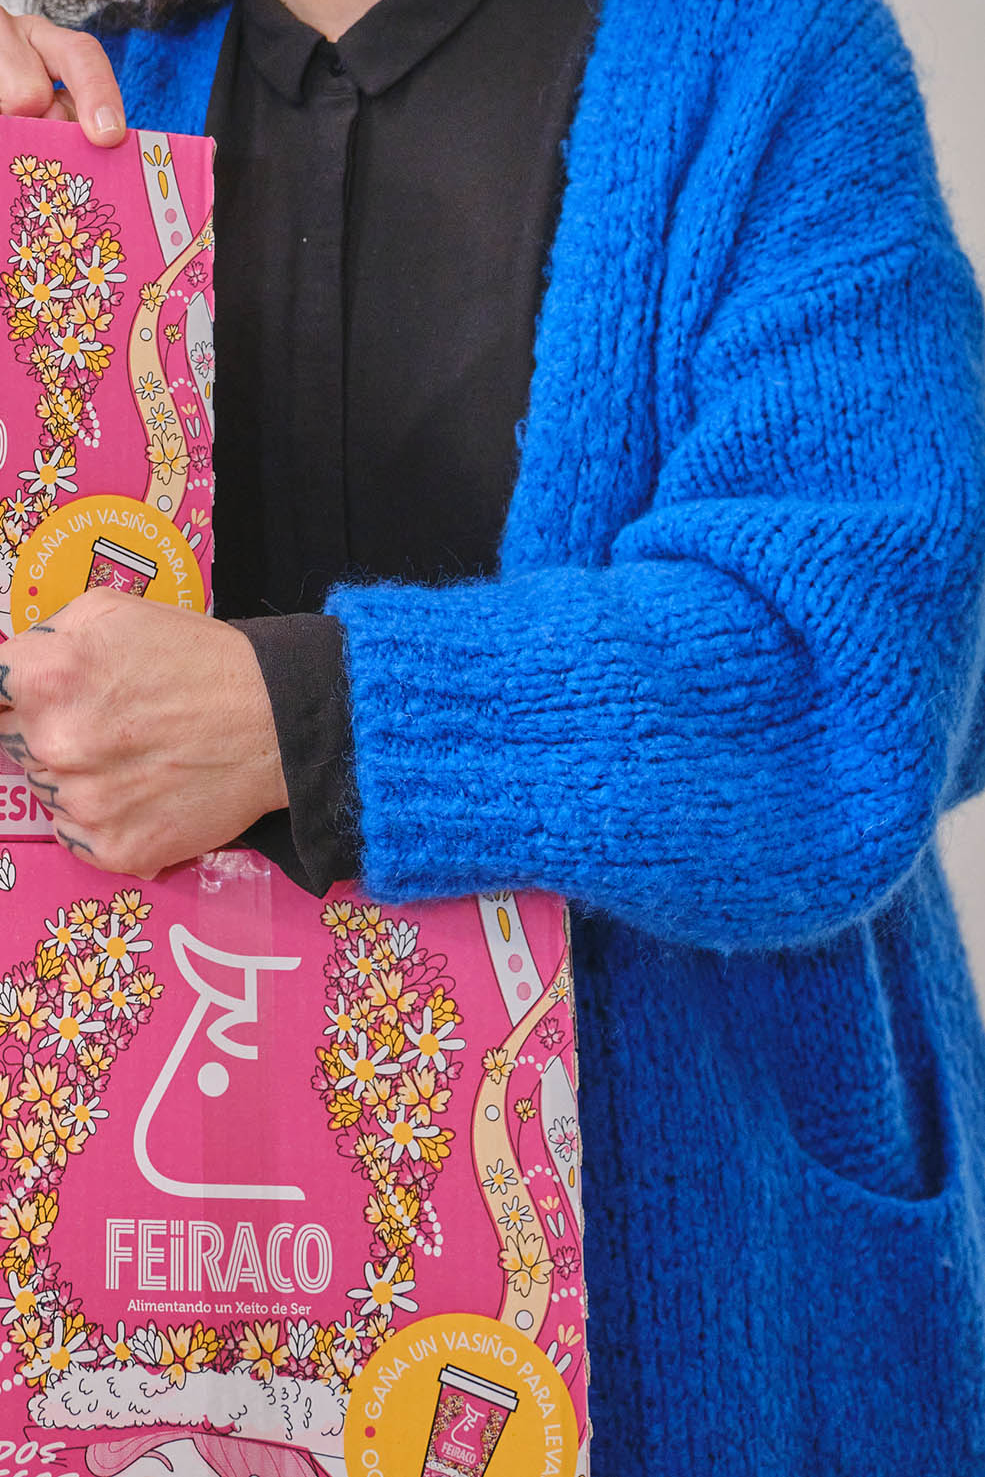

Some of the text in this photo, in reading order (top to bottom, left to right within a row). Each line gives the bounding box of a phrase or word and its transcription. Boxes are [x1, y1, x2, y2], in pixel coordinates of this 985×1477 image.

[28, 527, 70, 581] GAÑA
[68, 509, 93, 533] UN
[97, 507, 158, 540] VASIÑO
[156, 536, 189, 586] PARA
[127, 1299, 312, 1316] Alimentando un Xeito de Ser
[364, 1331, 564, 1477] GAÑA UN VASIÑO PARA LEVA
